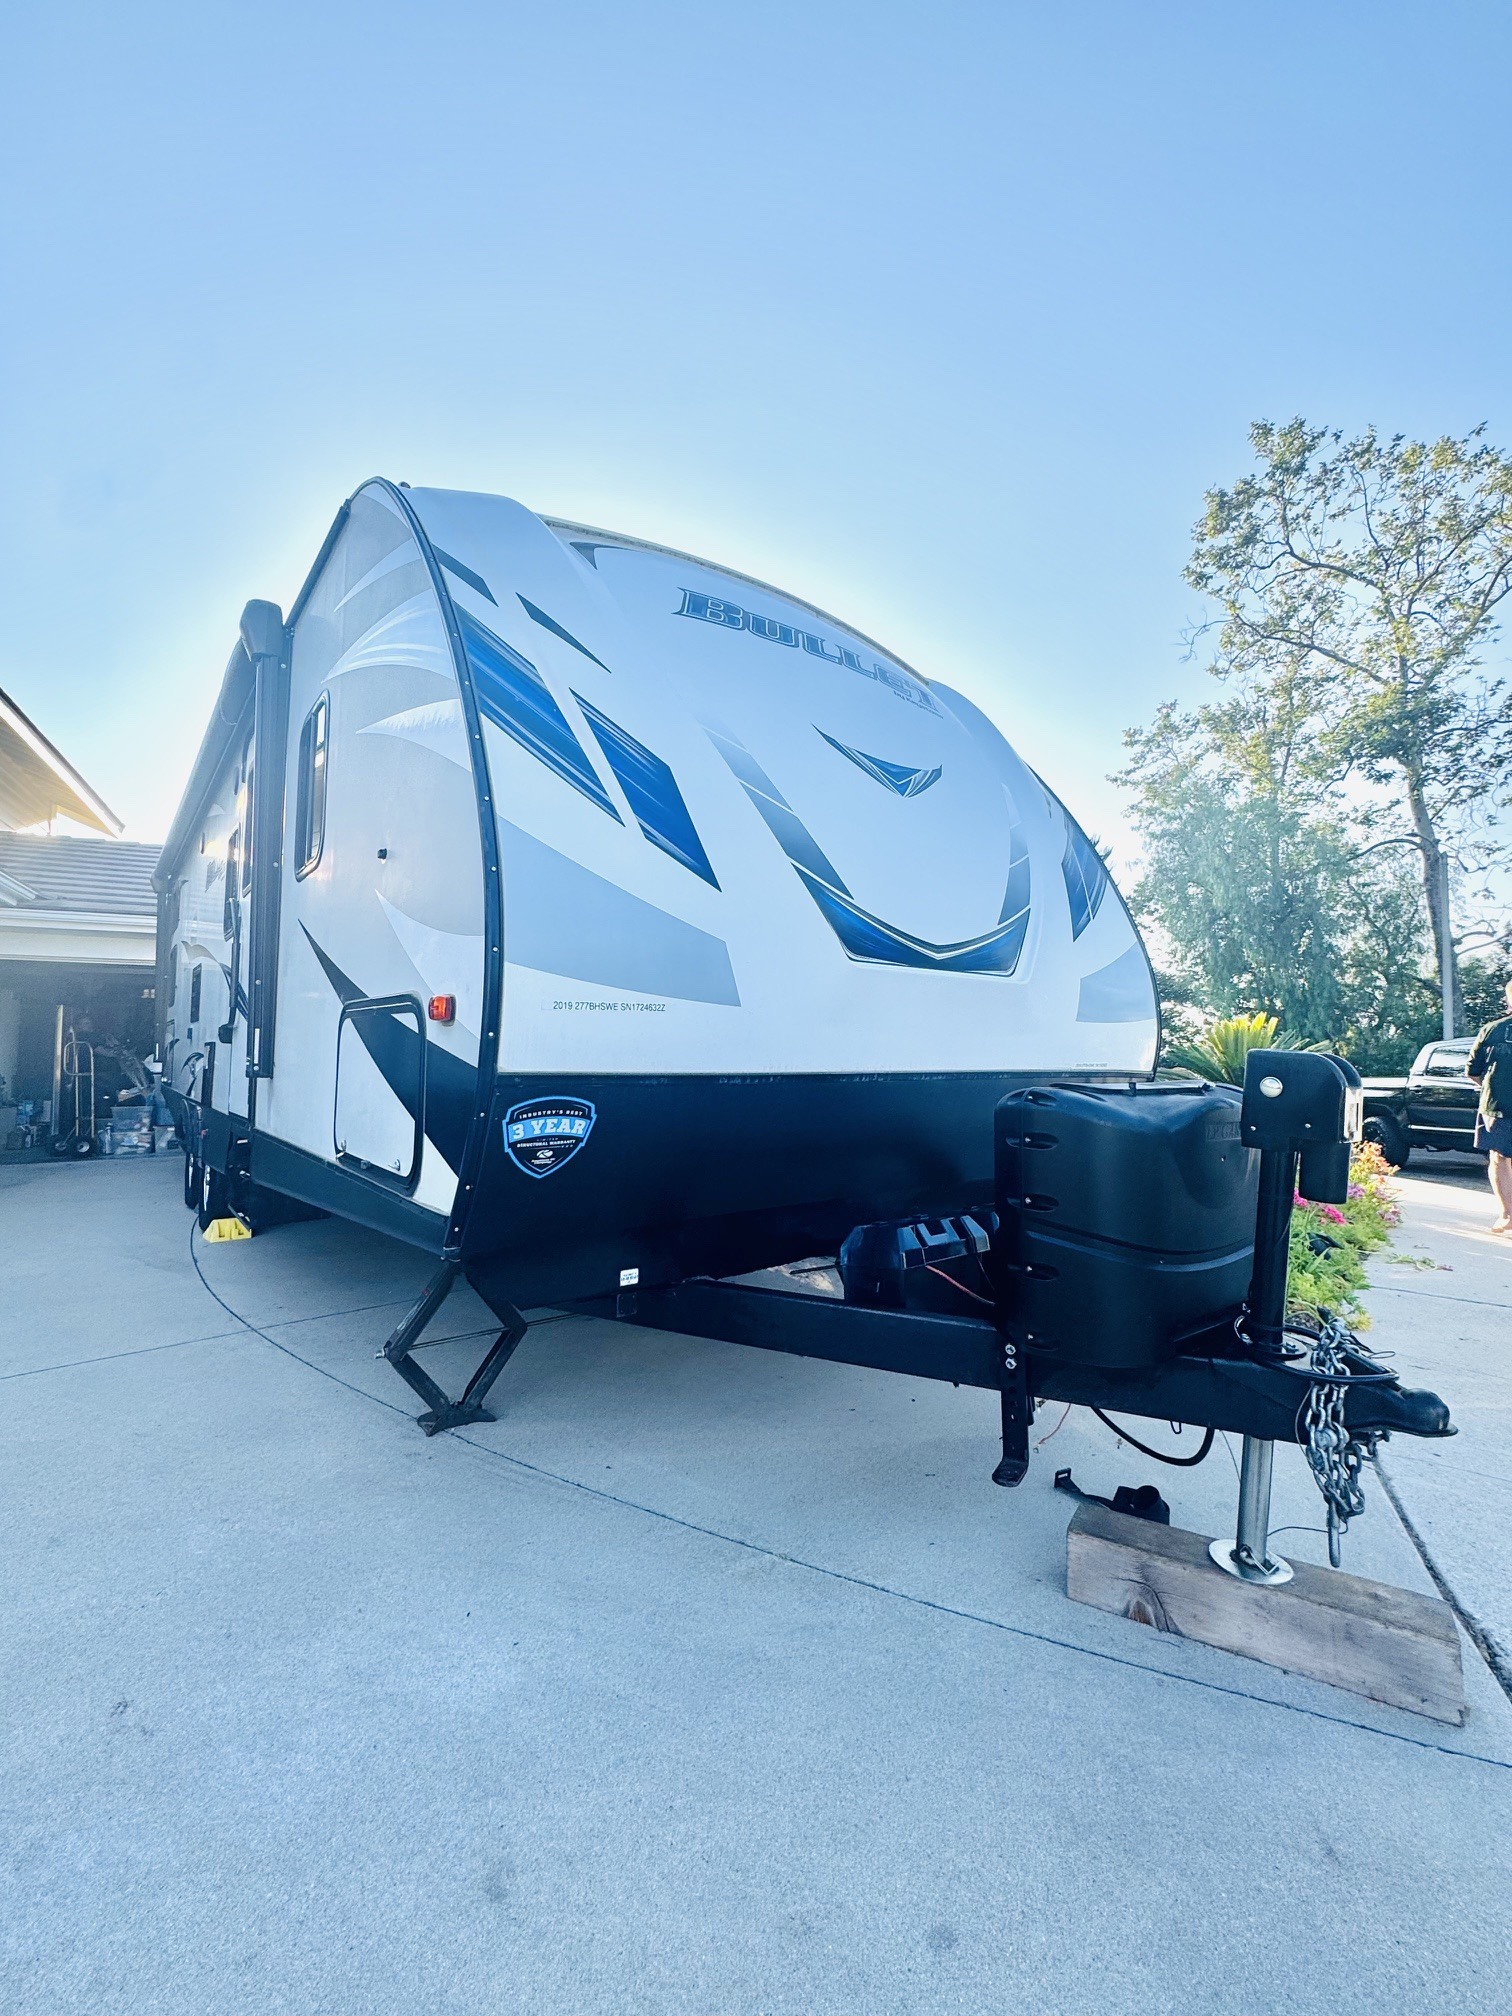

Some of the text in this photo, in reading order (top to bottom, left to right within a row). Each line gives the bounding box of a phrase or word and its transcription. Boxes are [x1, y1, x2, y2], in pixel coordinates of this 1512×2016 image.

[672, 587, 940, 713] BULLET
[553, 1001, 666, 1012] 2019 277BHSWE SN1724632Z
[519, 1109, 564, 1119] INDUSTRY'S
[512, 1118, 587, 1140] 3 YEAR
